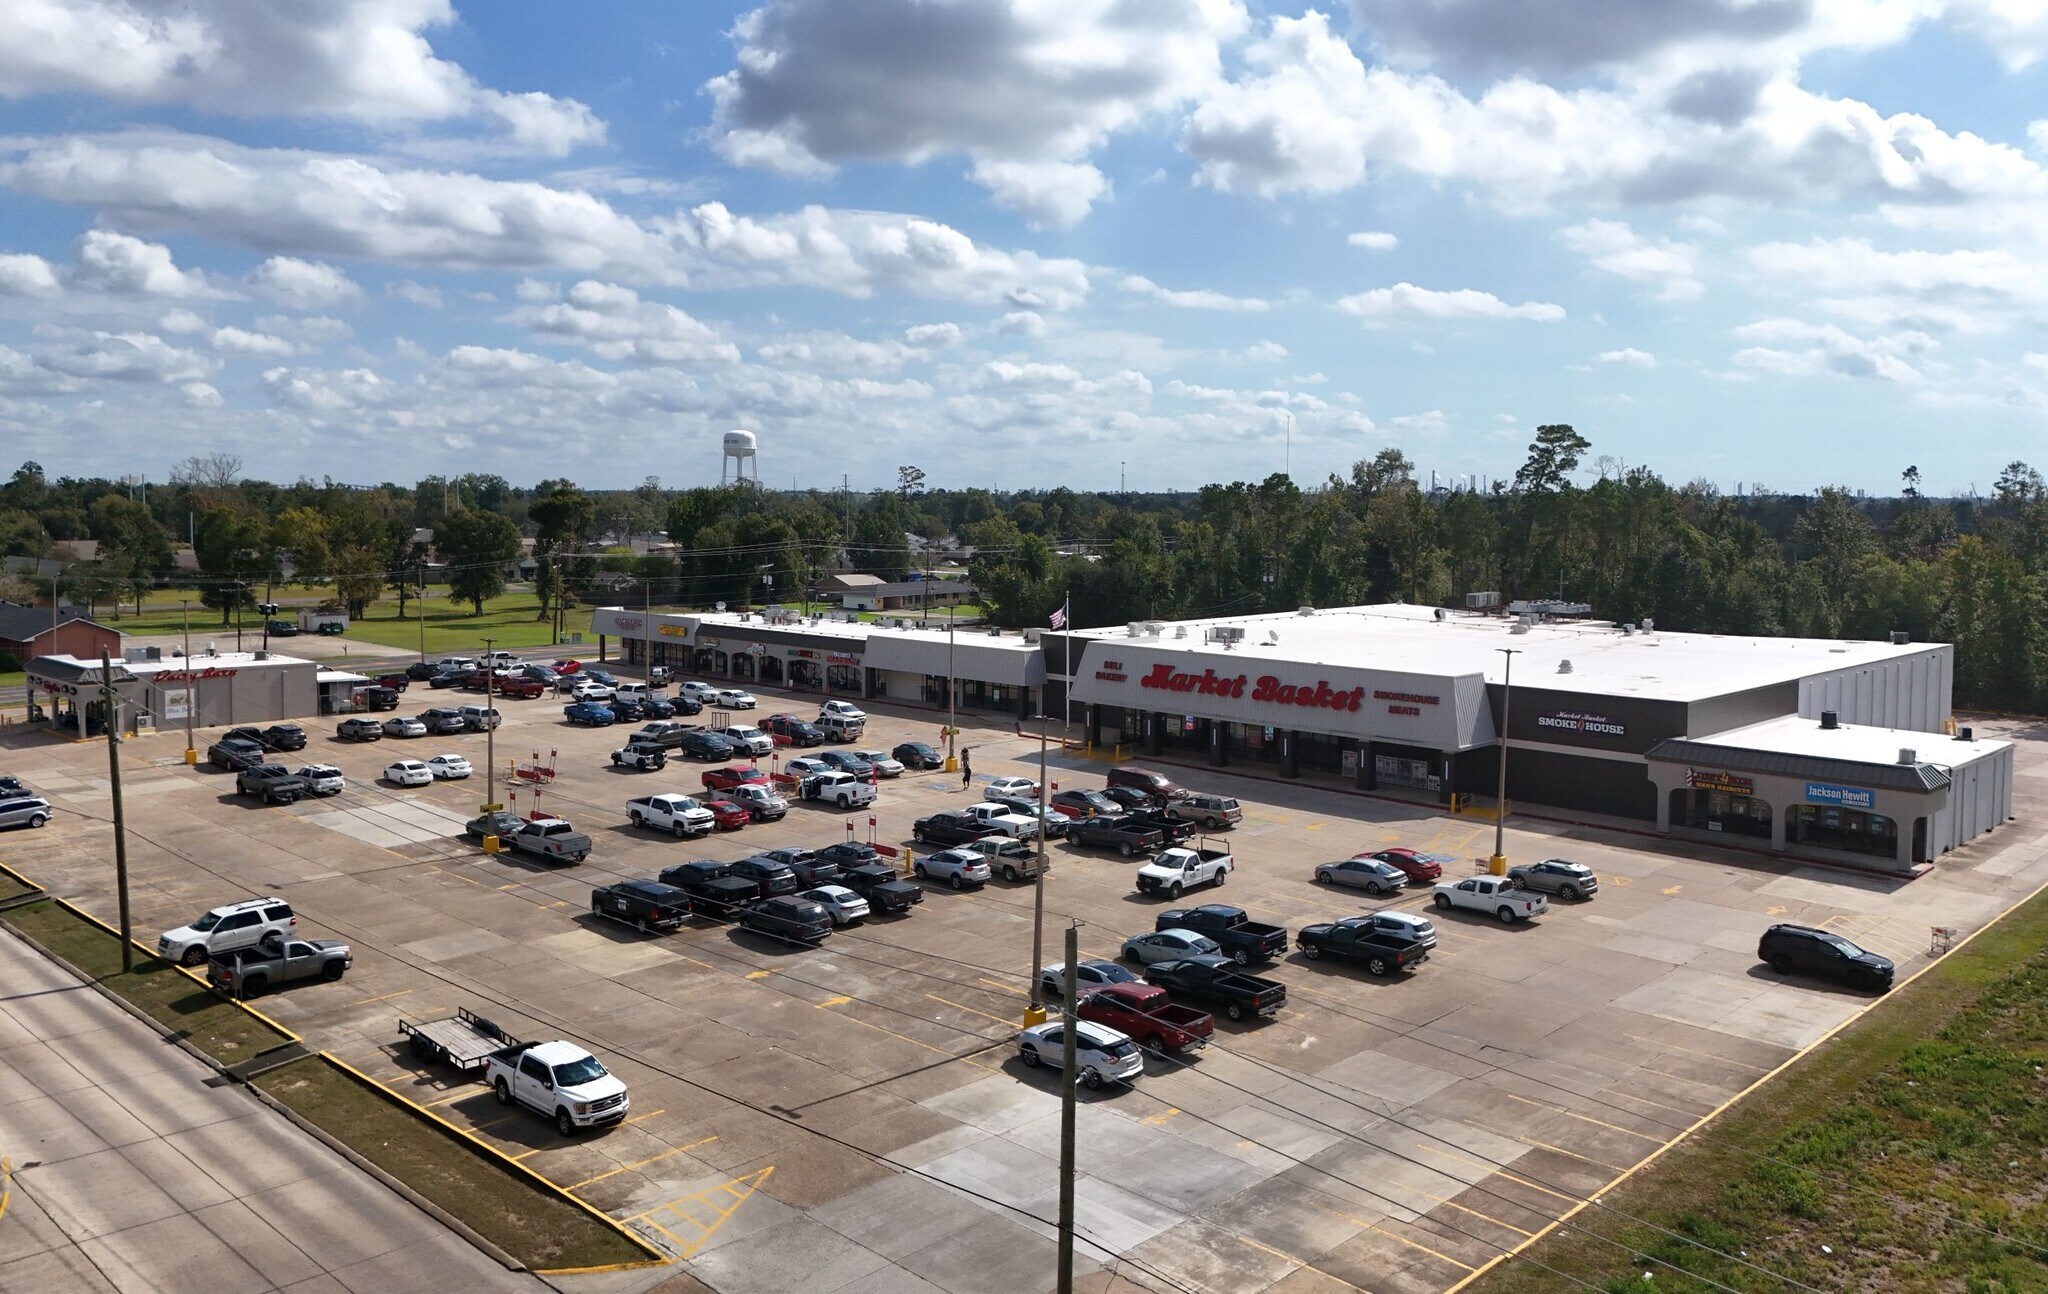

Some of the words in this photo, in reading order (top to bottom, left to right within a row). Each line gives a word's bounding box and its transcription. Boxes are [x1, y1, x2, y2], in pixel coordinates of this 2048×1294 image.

[1095, 672, 1127, 682] BAKERY
[1141, 664, 1247, 698] Market
[1252, 676, 1364, 712] Basket
[1373, 690, 1440, 705] SMOKEHOUSE
[1388, 705, 1420, 716] MEATS
[1538, 717, 1577, 729] SMOKE
[1585, 722, 1624, 735] HOUSE
[1808, 785, 1841, 799] Jackson
[1842, 789, 1870, 803] Hewitt
